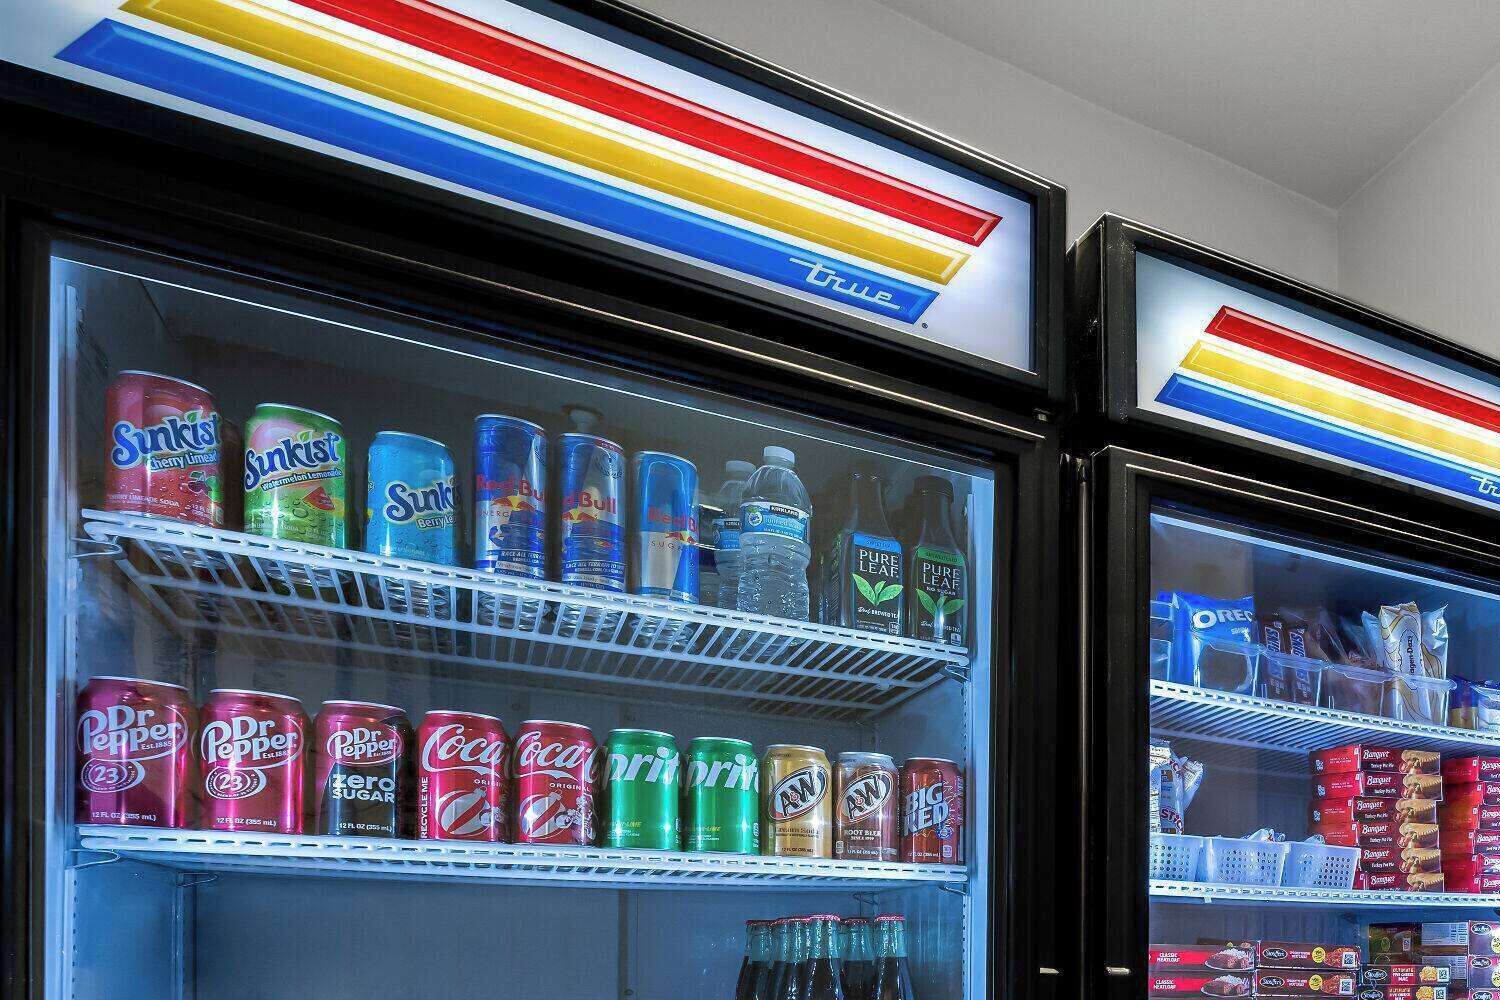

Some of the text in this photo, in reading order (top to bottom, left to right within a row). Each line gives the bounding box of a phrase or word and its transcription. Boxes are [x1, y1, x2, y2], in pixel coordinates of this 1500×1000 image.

[111, 410, 222, 468] Sunkist
[244, 430, 341, 492] Sunkist
[261, 473, 307, 491] Watermelon
[578, 491, 617, 515] Bull
[859, 549, 899, 566] PURE
[860, 561, 899, 578] LEAF
[922, 562, 961, 578] PURE
[922, 574, 961, 590] LEAF
[107, 704, 155, 732] Dr
[230, 716, 276, 742] Dr
[81, 709, 182, 755] Pepper
[203, 720, 298, 764] Pepper
[329, 730, 397, 760] Pepper
[94, 765, 119, 784] 23
[219, 774, 243, 790] 23
[332, 773, 396, 792] zero
[332, 790, 396, 803] SUGAR
[420, 776, 429, 839] RECYCLE ME
[905, 782, 945, 810] BIG
[903, 801, 949, 836] RED
